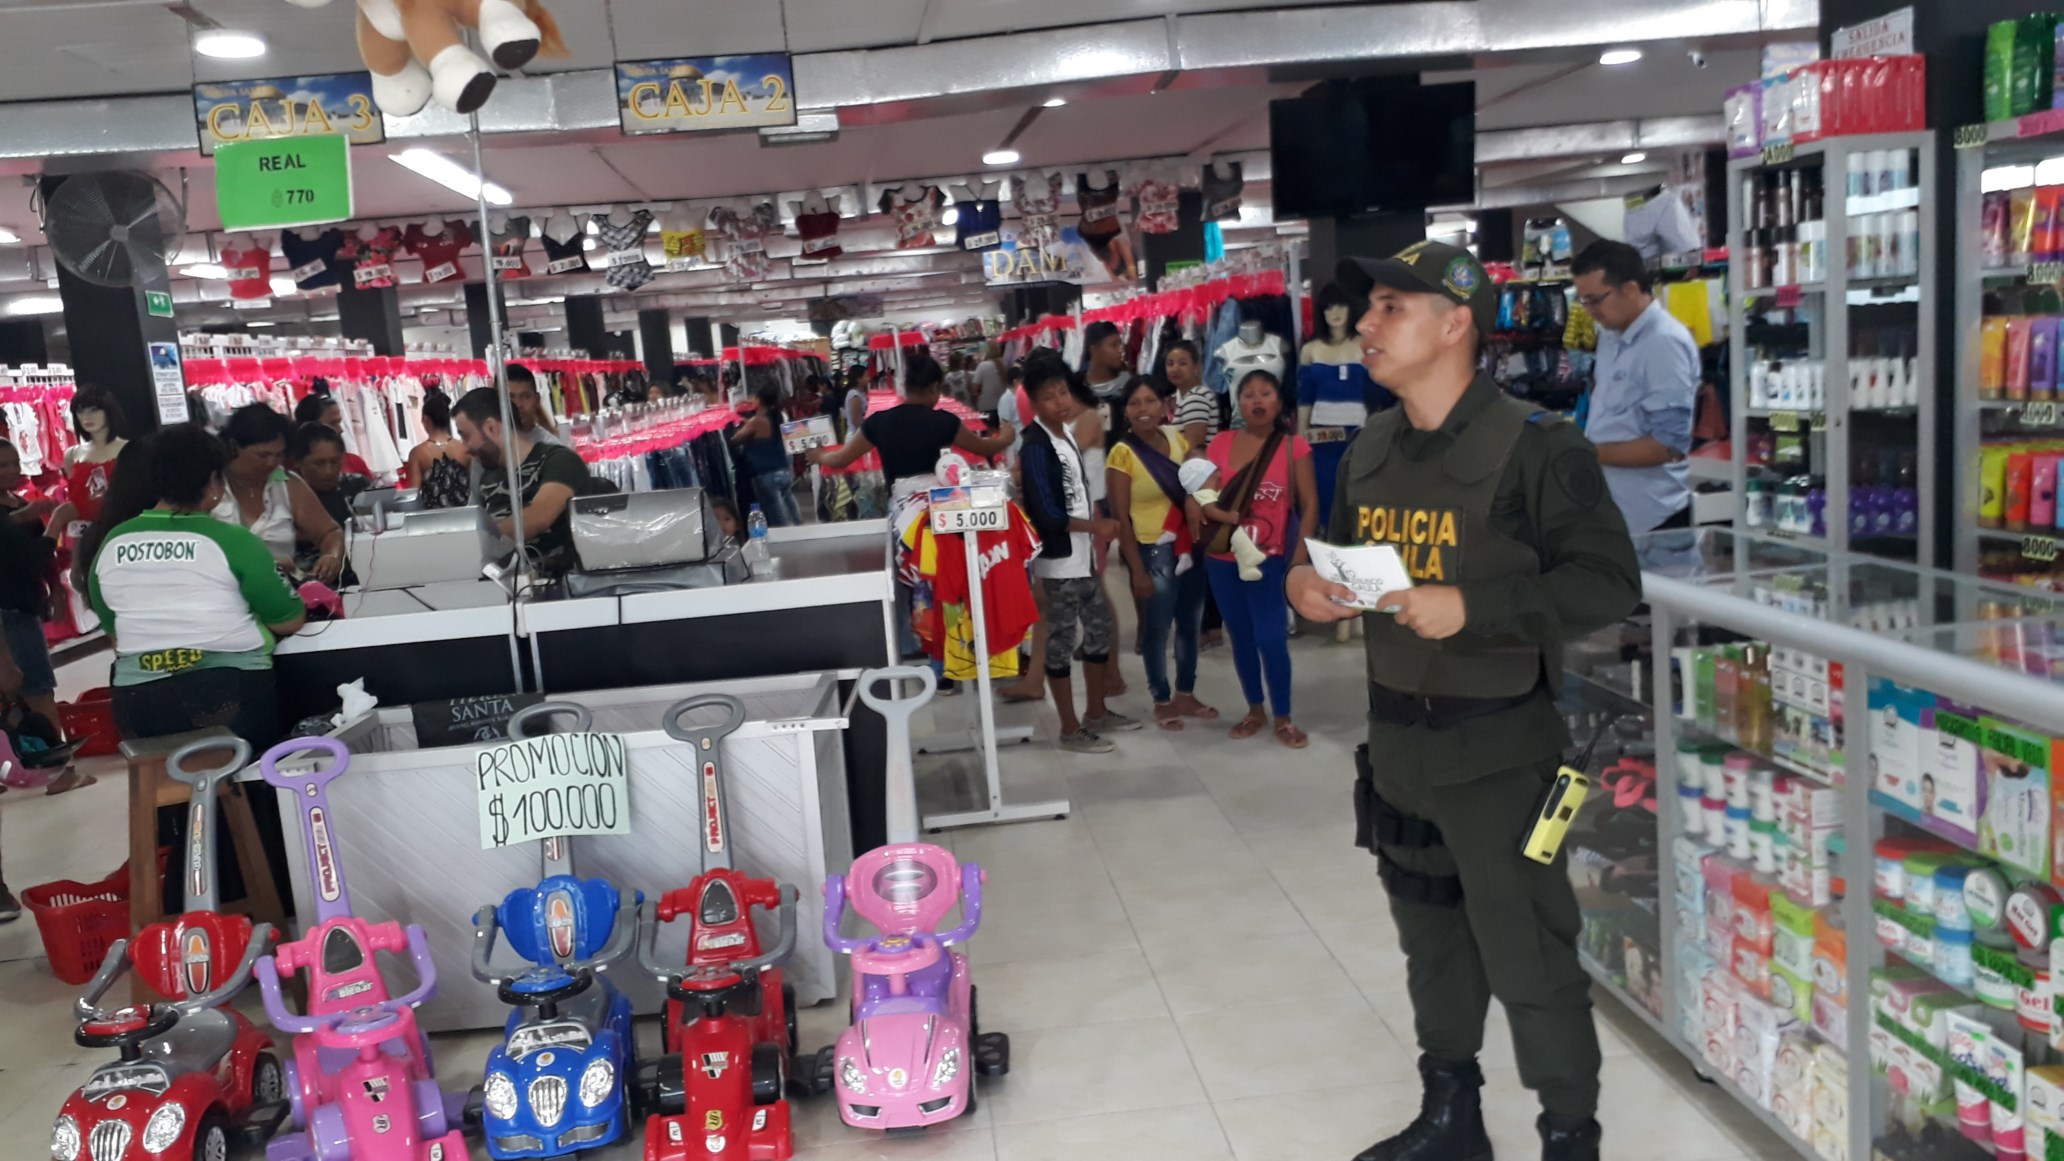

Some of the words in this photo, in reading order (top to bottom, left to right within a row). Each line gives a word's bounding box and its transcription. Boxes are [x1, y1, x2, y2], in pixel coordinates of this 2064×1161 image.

[628, 79, 748, 120] CAJA
[762, 74, 787, 113] 2
[207, 99, 335, 141] CAJA
[347, 93, 373, 131] 3
[259, 153, 307, 172] REAL
[286, 189, 315, 205] 770
[938, 512, 947, 529] $
[956, 511, 998, 529] 5.000
[1357, 506, 1458, 547] POLICIA
[116, 541, 197, 564] POSTOBON
[451, 699, 514, 722] SANTA
[478, 733, 624, 791] PROMOCION
